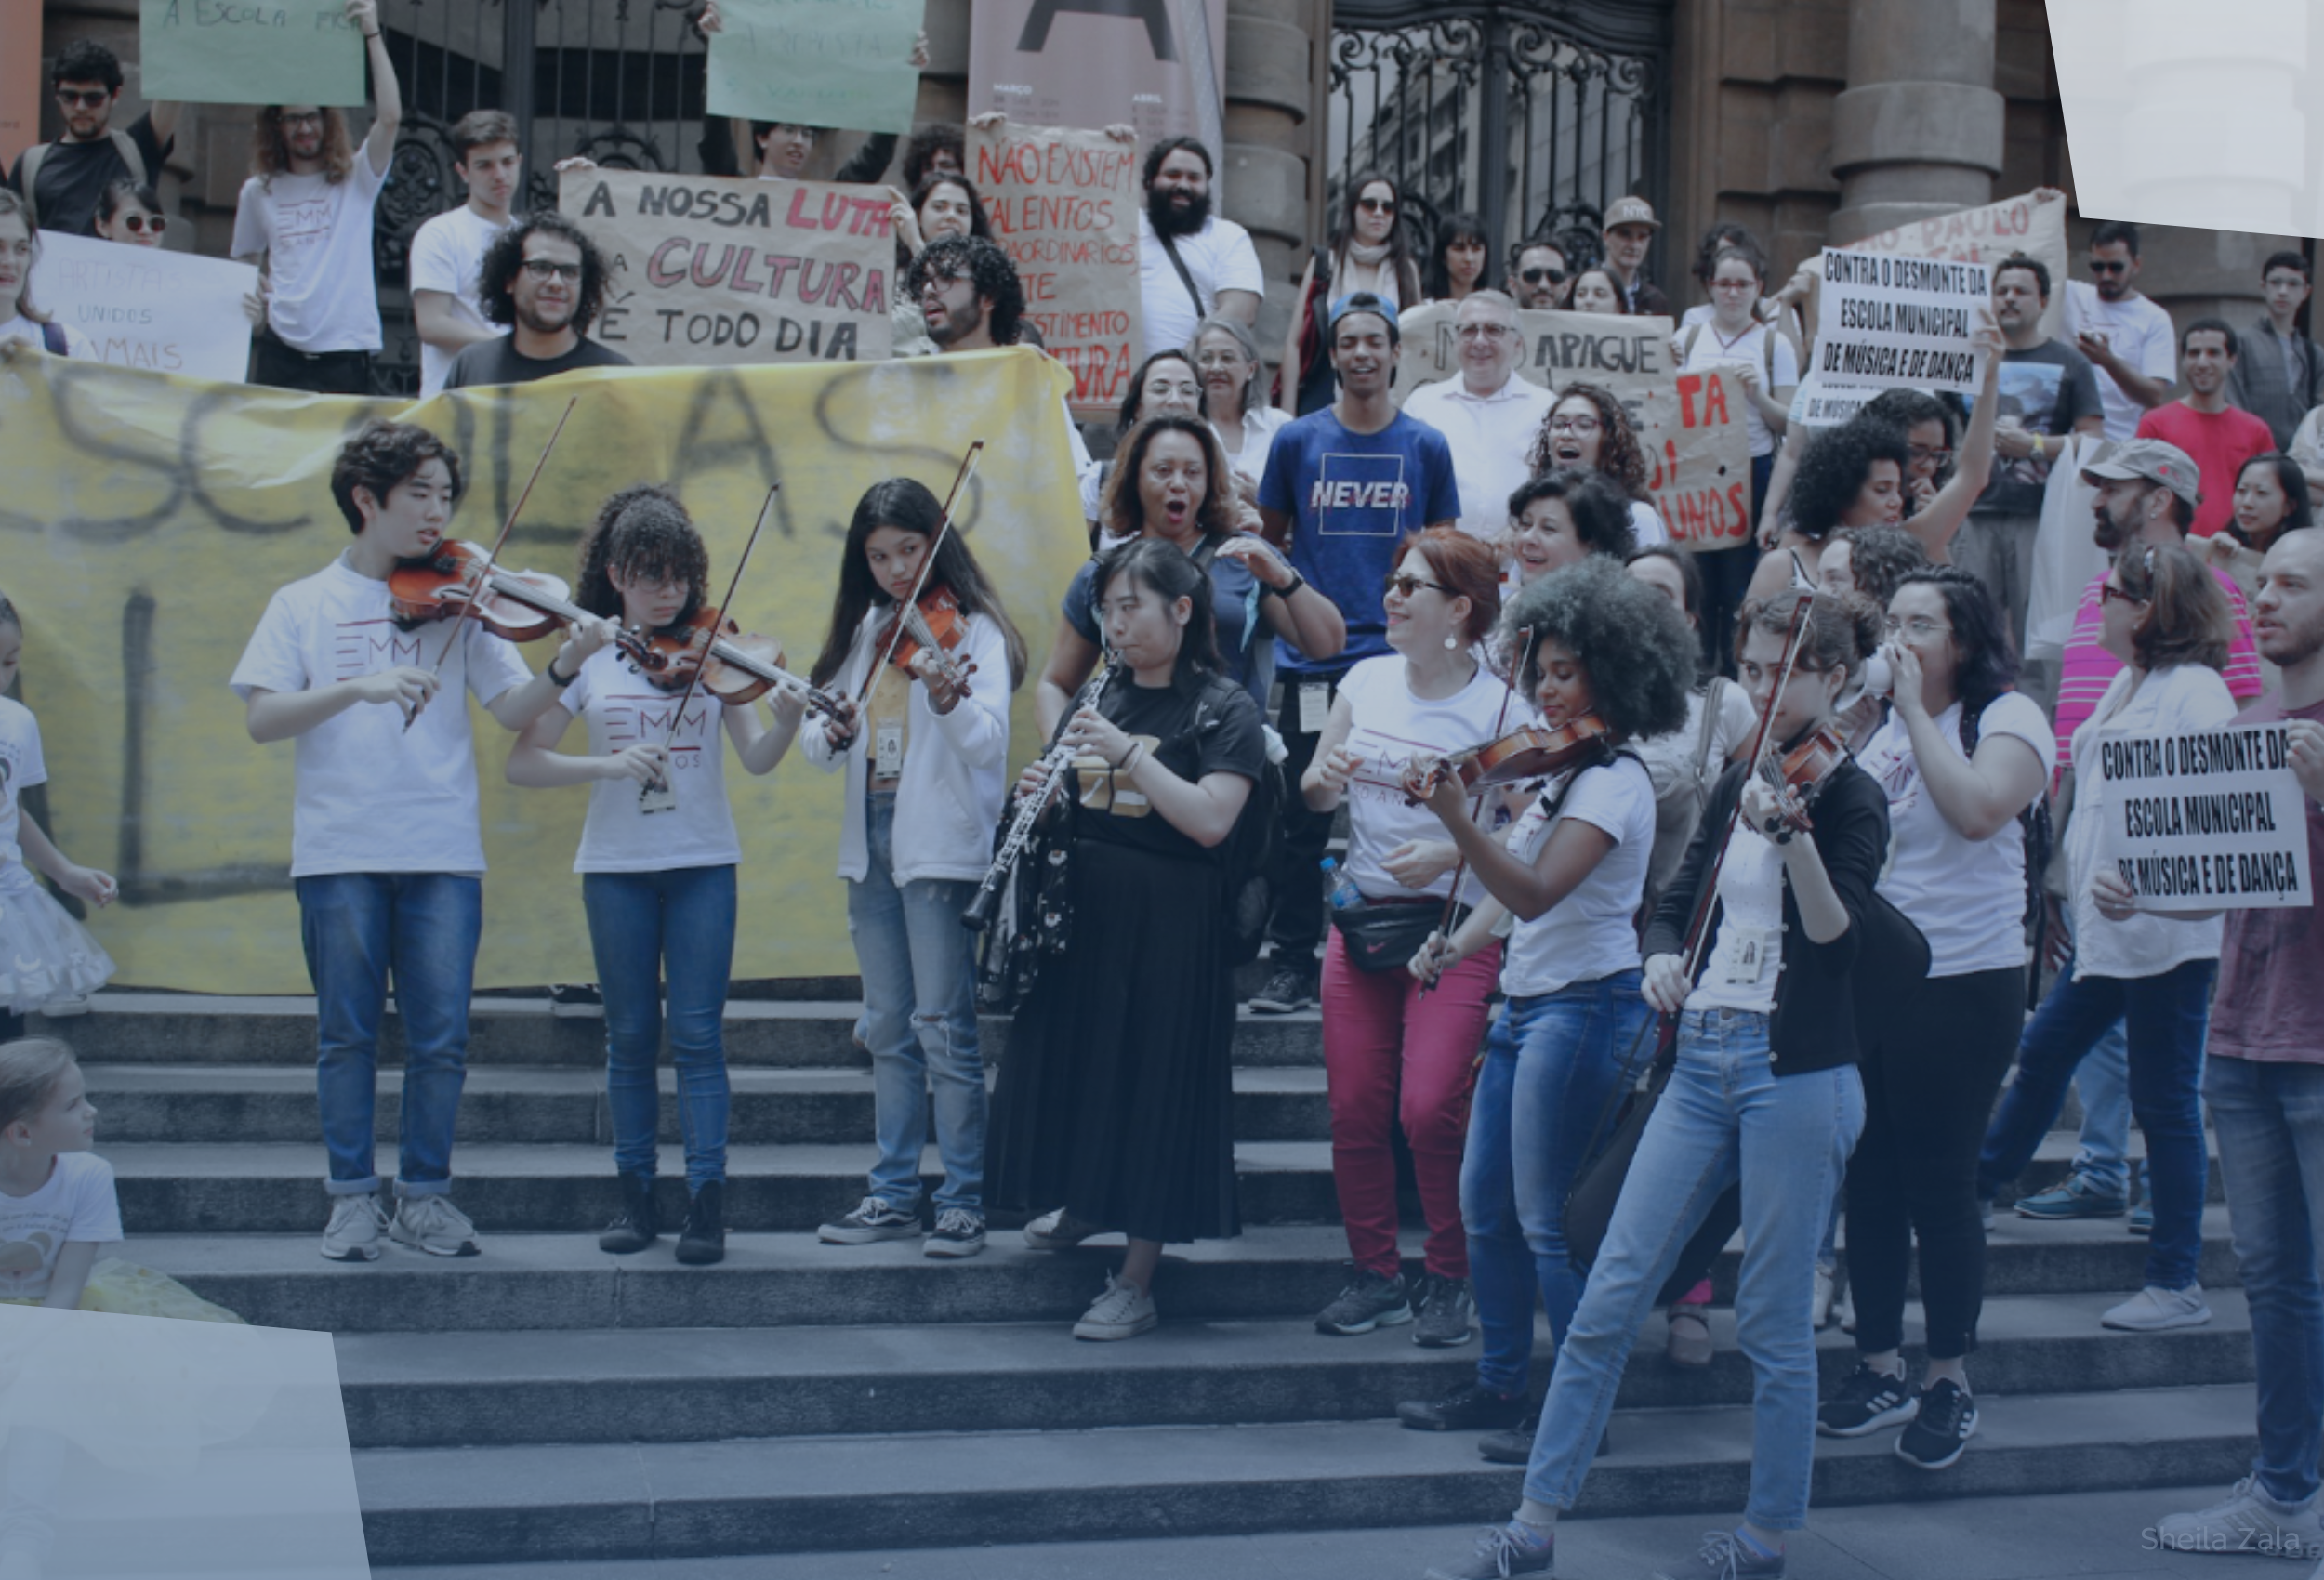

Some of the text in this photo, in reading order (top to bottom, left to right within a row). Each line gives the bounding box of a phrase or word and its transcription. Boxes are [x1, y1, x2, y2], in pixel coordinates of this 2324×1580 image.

[196, 0, 286, 29] ESCOLA
[978, 137, 1136, 193] NÃO EXISTEM
[582, 180, 893, 237] A NOSSA LUTA
[1921, 202, 2029, 248] PAULO
[614, 237, 887, 314] A CULTURA
[1825, 251, 1879, 286] CONTRA
[1882, 258, 1891, 287] O
[1894, 259, 1966, 295] DESMONTE
[1969, 268, 1987, 296] DA
[78, 304, 152, 325] UNIDOS
[599, 291, 857, 361] É TODO DIA
[1841, 298, 1968, 338] ESCOLA MUNICIPAL
[1534, 332, 1660, 375] APAGUE
[1823, 339, 1974, 388] DE MÚSICA E DE DANÇA
[1311, 481, 1409, 510] NEVER
[2102, 738, 2162, 781] CONTRA
[2165, 737, 2175, 776] O
[2178, 730, 2264, 775] DESMONTE
[2125, 791, 2276, 838] ESCOLA MUNICIPAL
[2137, 849, 2199, 896] MÚSICA
[2201, 854, 2212, 894] E
[2213, 853, 2237, 894] DE
[2238, 851, 2298, 901] DANÇA
